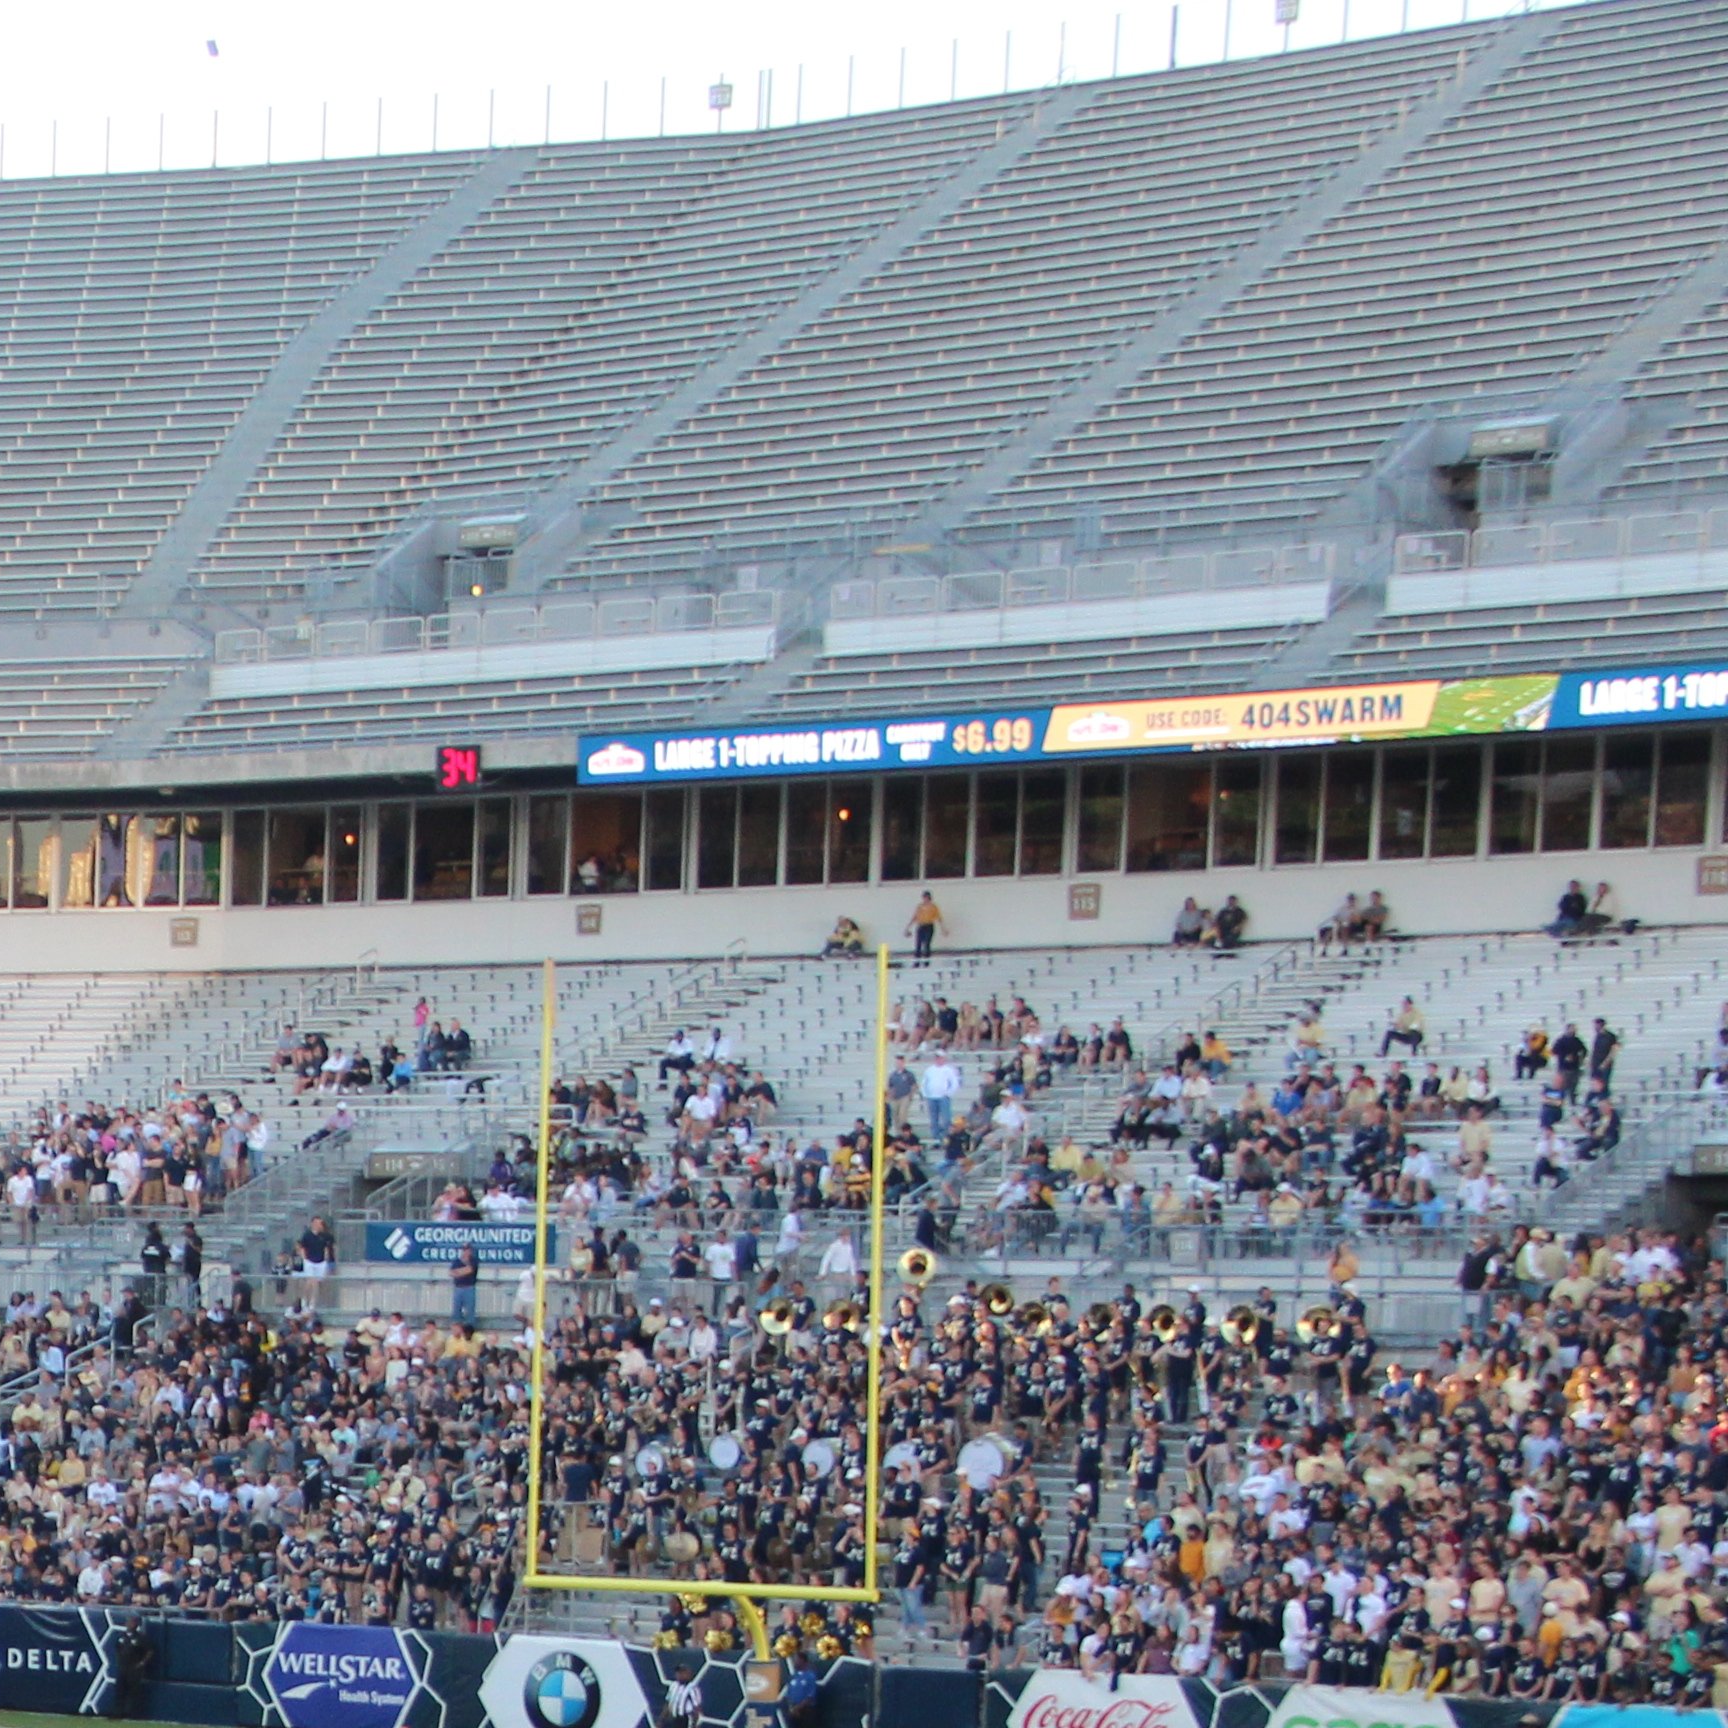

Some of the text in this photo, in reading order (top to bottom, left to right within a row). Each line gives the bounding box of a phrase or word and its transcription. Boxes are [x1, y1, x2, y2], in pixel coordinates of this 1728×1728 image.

[1241, 694, 1404, 730] 404SWARM
[1579, 677, 1660, 716] LARGE
[654, 729, 880, 771] LARGE 1-TOPPING PIZZA
[952, 718, 1032, 754] $6.99
[441, 748, 477, 788] 34
[478, 1249, 523, 1261] UNION
[8, 1649, 93, 1673] DELTA
[279, 1652, 401, 1684] WELLSTAR
[532, 1653, 596, 1687] BMW
[339, 1689, 405, 1706] Health System
